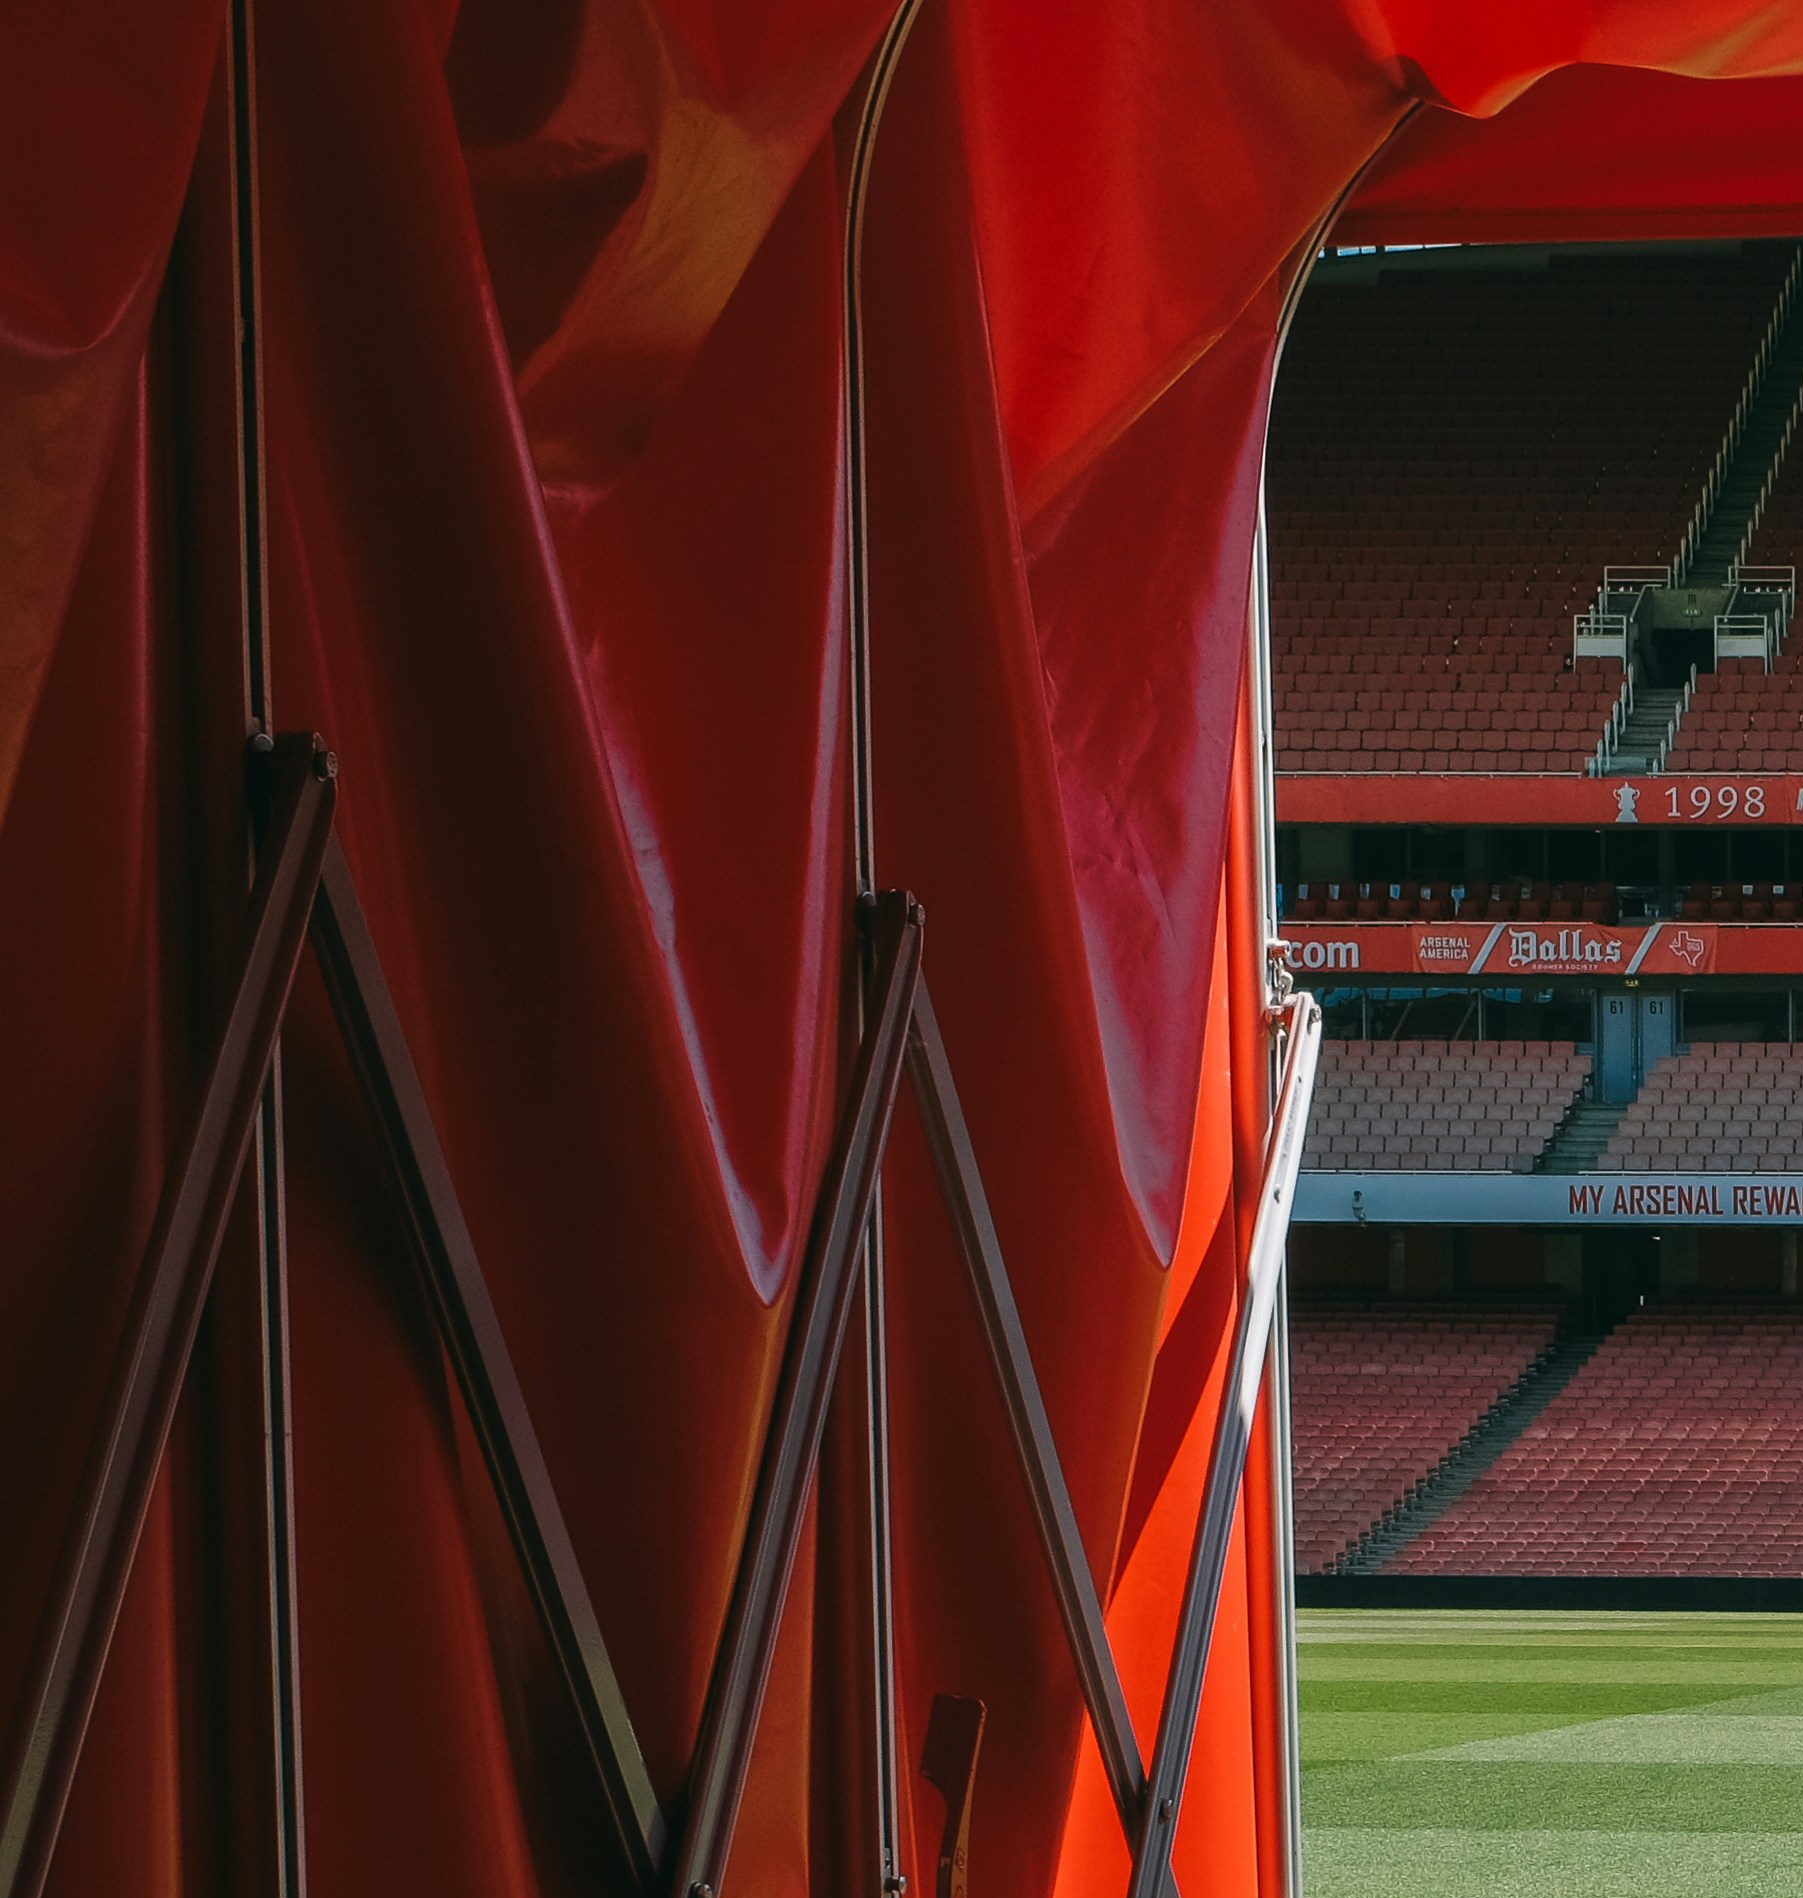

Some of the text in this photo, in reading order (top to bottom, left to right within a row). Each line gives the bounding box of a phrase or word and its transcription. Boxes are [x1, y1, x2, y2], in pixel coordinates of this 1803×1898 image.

[1664, 786, 1766, 819] 1998
[1419, 937, 1470, 948] ARSENAL
[1508, 927, 1622, 967] Dallas
[1418, 948, 1469, 959] AMERICA
[1609, 1000, 1624, 1015] 61
[1649, 1000, 1664, 1015] 61
[1568, 1185, 1606, 1216] MY
[1613, 1185, 1725, 1216] ARSENAL
